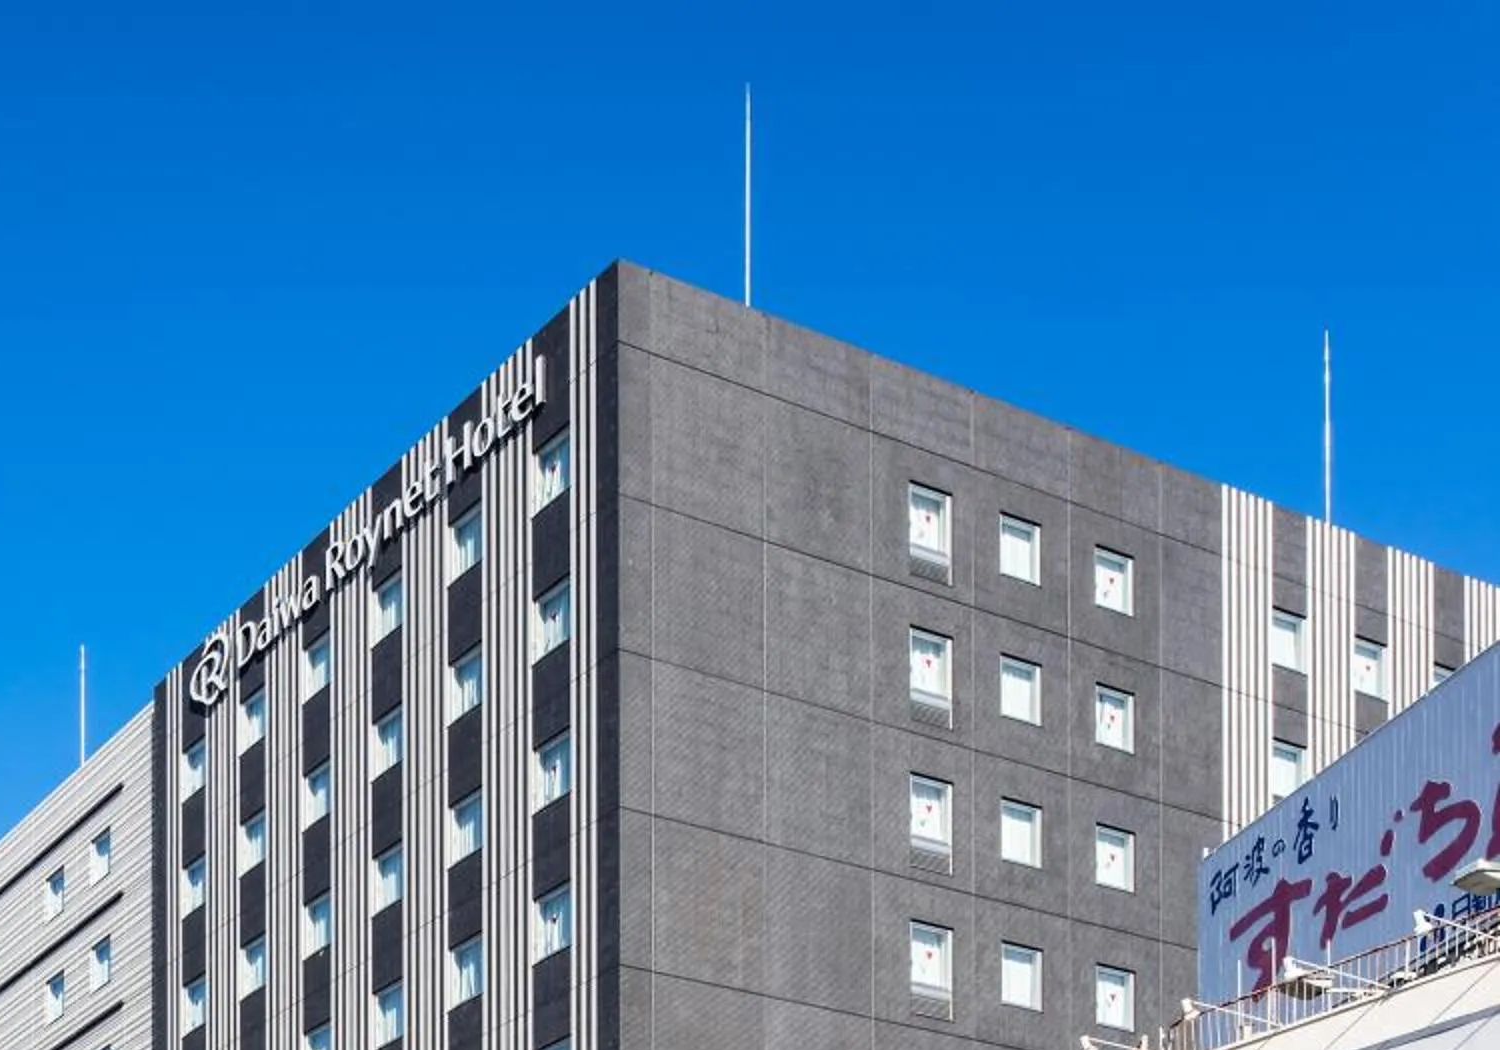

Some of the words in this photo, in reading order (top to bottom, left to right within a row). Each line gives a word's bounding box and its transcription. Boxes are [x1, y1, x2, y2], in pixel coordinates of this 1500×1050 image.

[236, 574, 320, 668] Daiwa
[325, 456, 442, 591] Roynet
[446, 354, 546, 485] Hotel
[1209, 794, 1339, 916] 阿波の香り
[1230, 722, 1500, 1003] すだち
